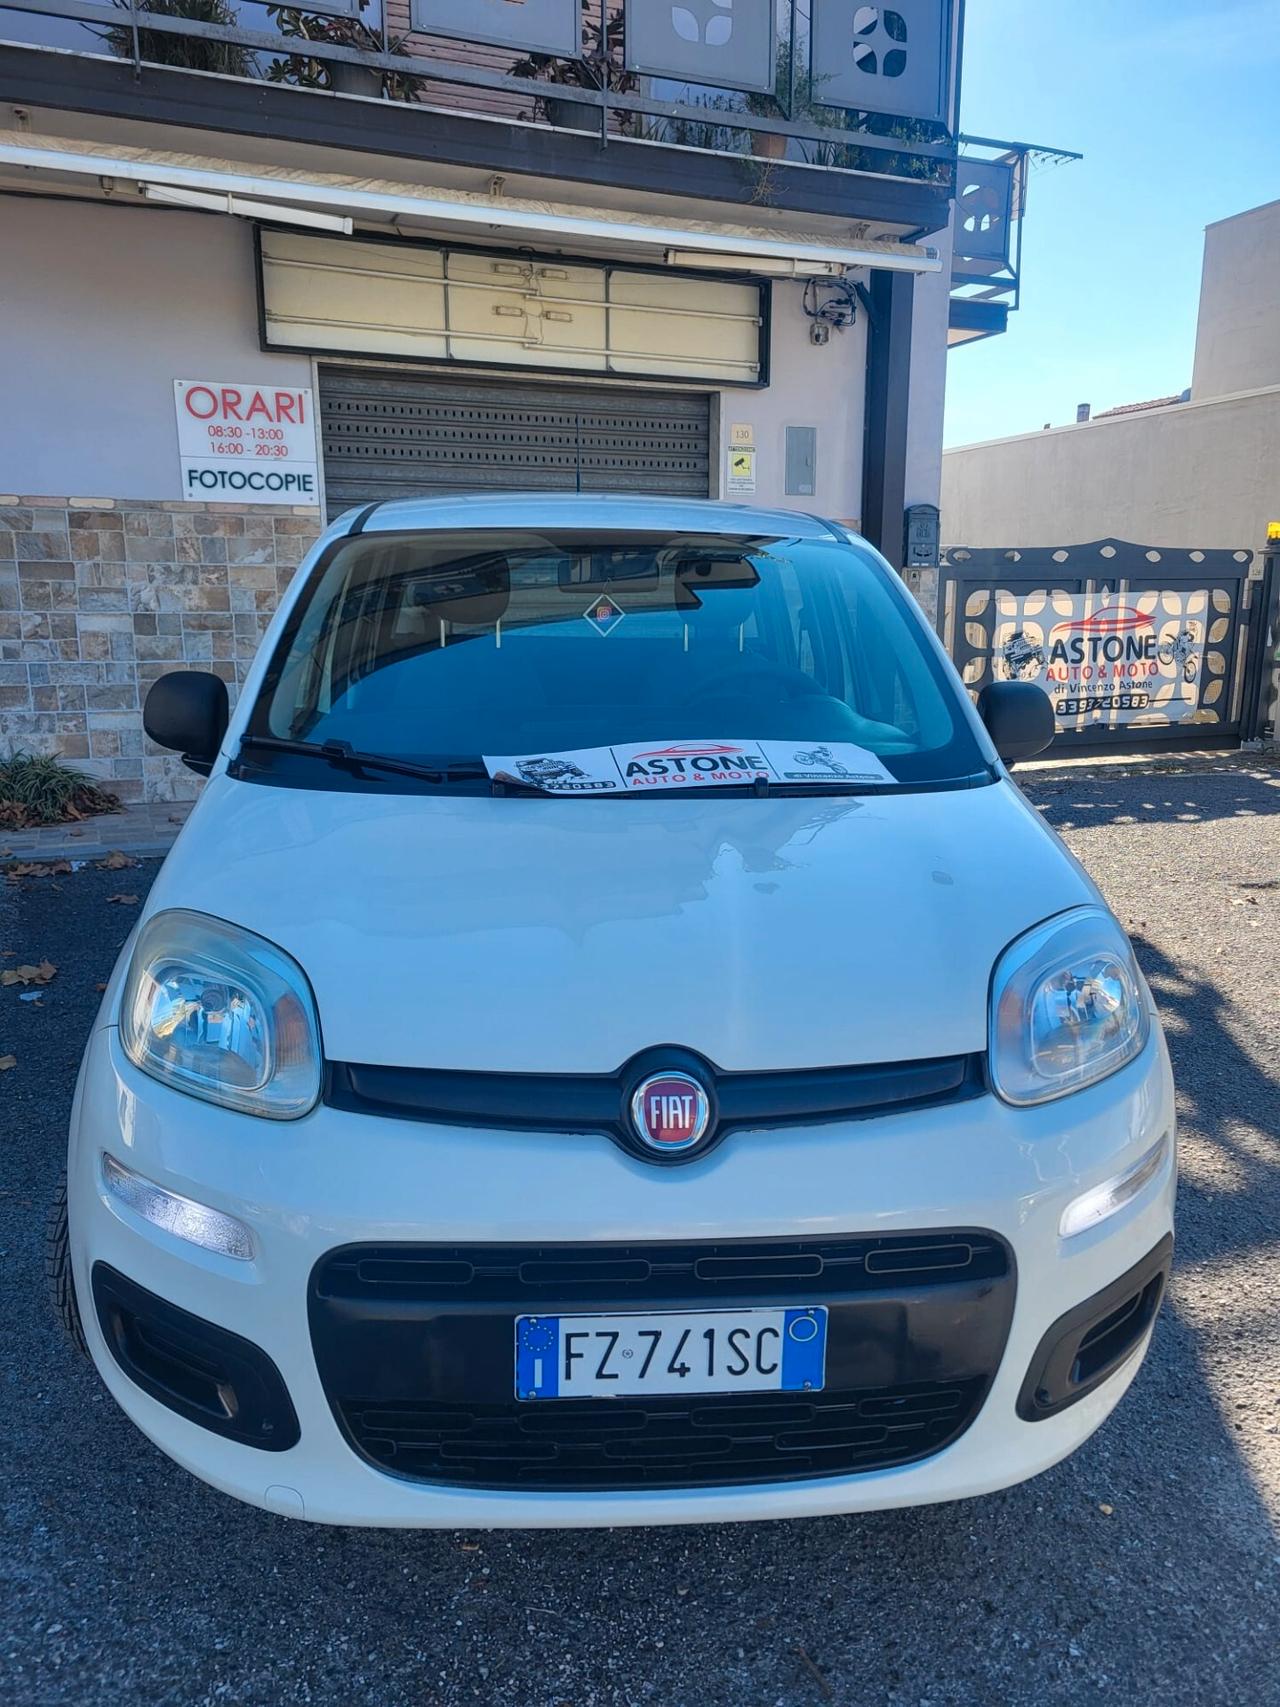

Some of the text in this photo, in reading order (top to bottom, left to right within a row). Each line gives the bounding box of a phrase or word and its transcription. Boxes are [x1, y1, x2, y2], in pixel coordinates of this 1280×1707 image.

[185, 386, 304, 424] ORARI
[208, 425, 242, 438] 08:30
[735, 430, 749, 439] 130
[210, 442, 243, 455] 16:00
[255, 444, 288, 456] 20:30
[188, 469, 313, 492] FOTOCOPIE
[1050, 634, 1157, 665] ASTONE
[1046, 662, 1159, 682] AUTO & MOTO
[1054, 680, 1153, 694] di Vincenzo Astone
[1057, 695, 1149, 714] 3393720583
[626, 756, 768, 777] ASTONE
[633, 771, 769, 785] AUTO & MOTO
[650, 1096, 693, 1129] FIAT
[534, 1359, 542, 1388] I
